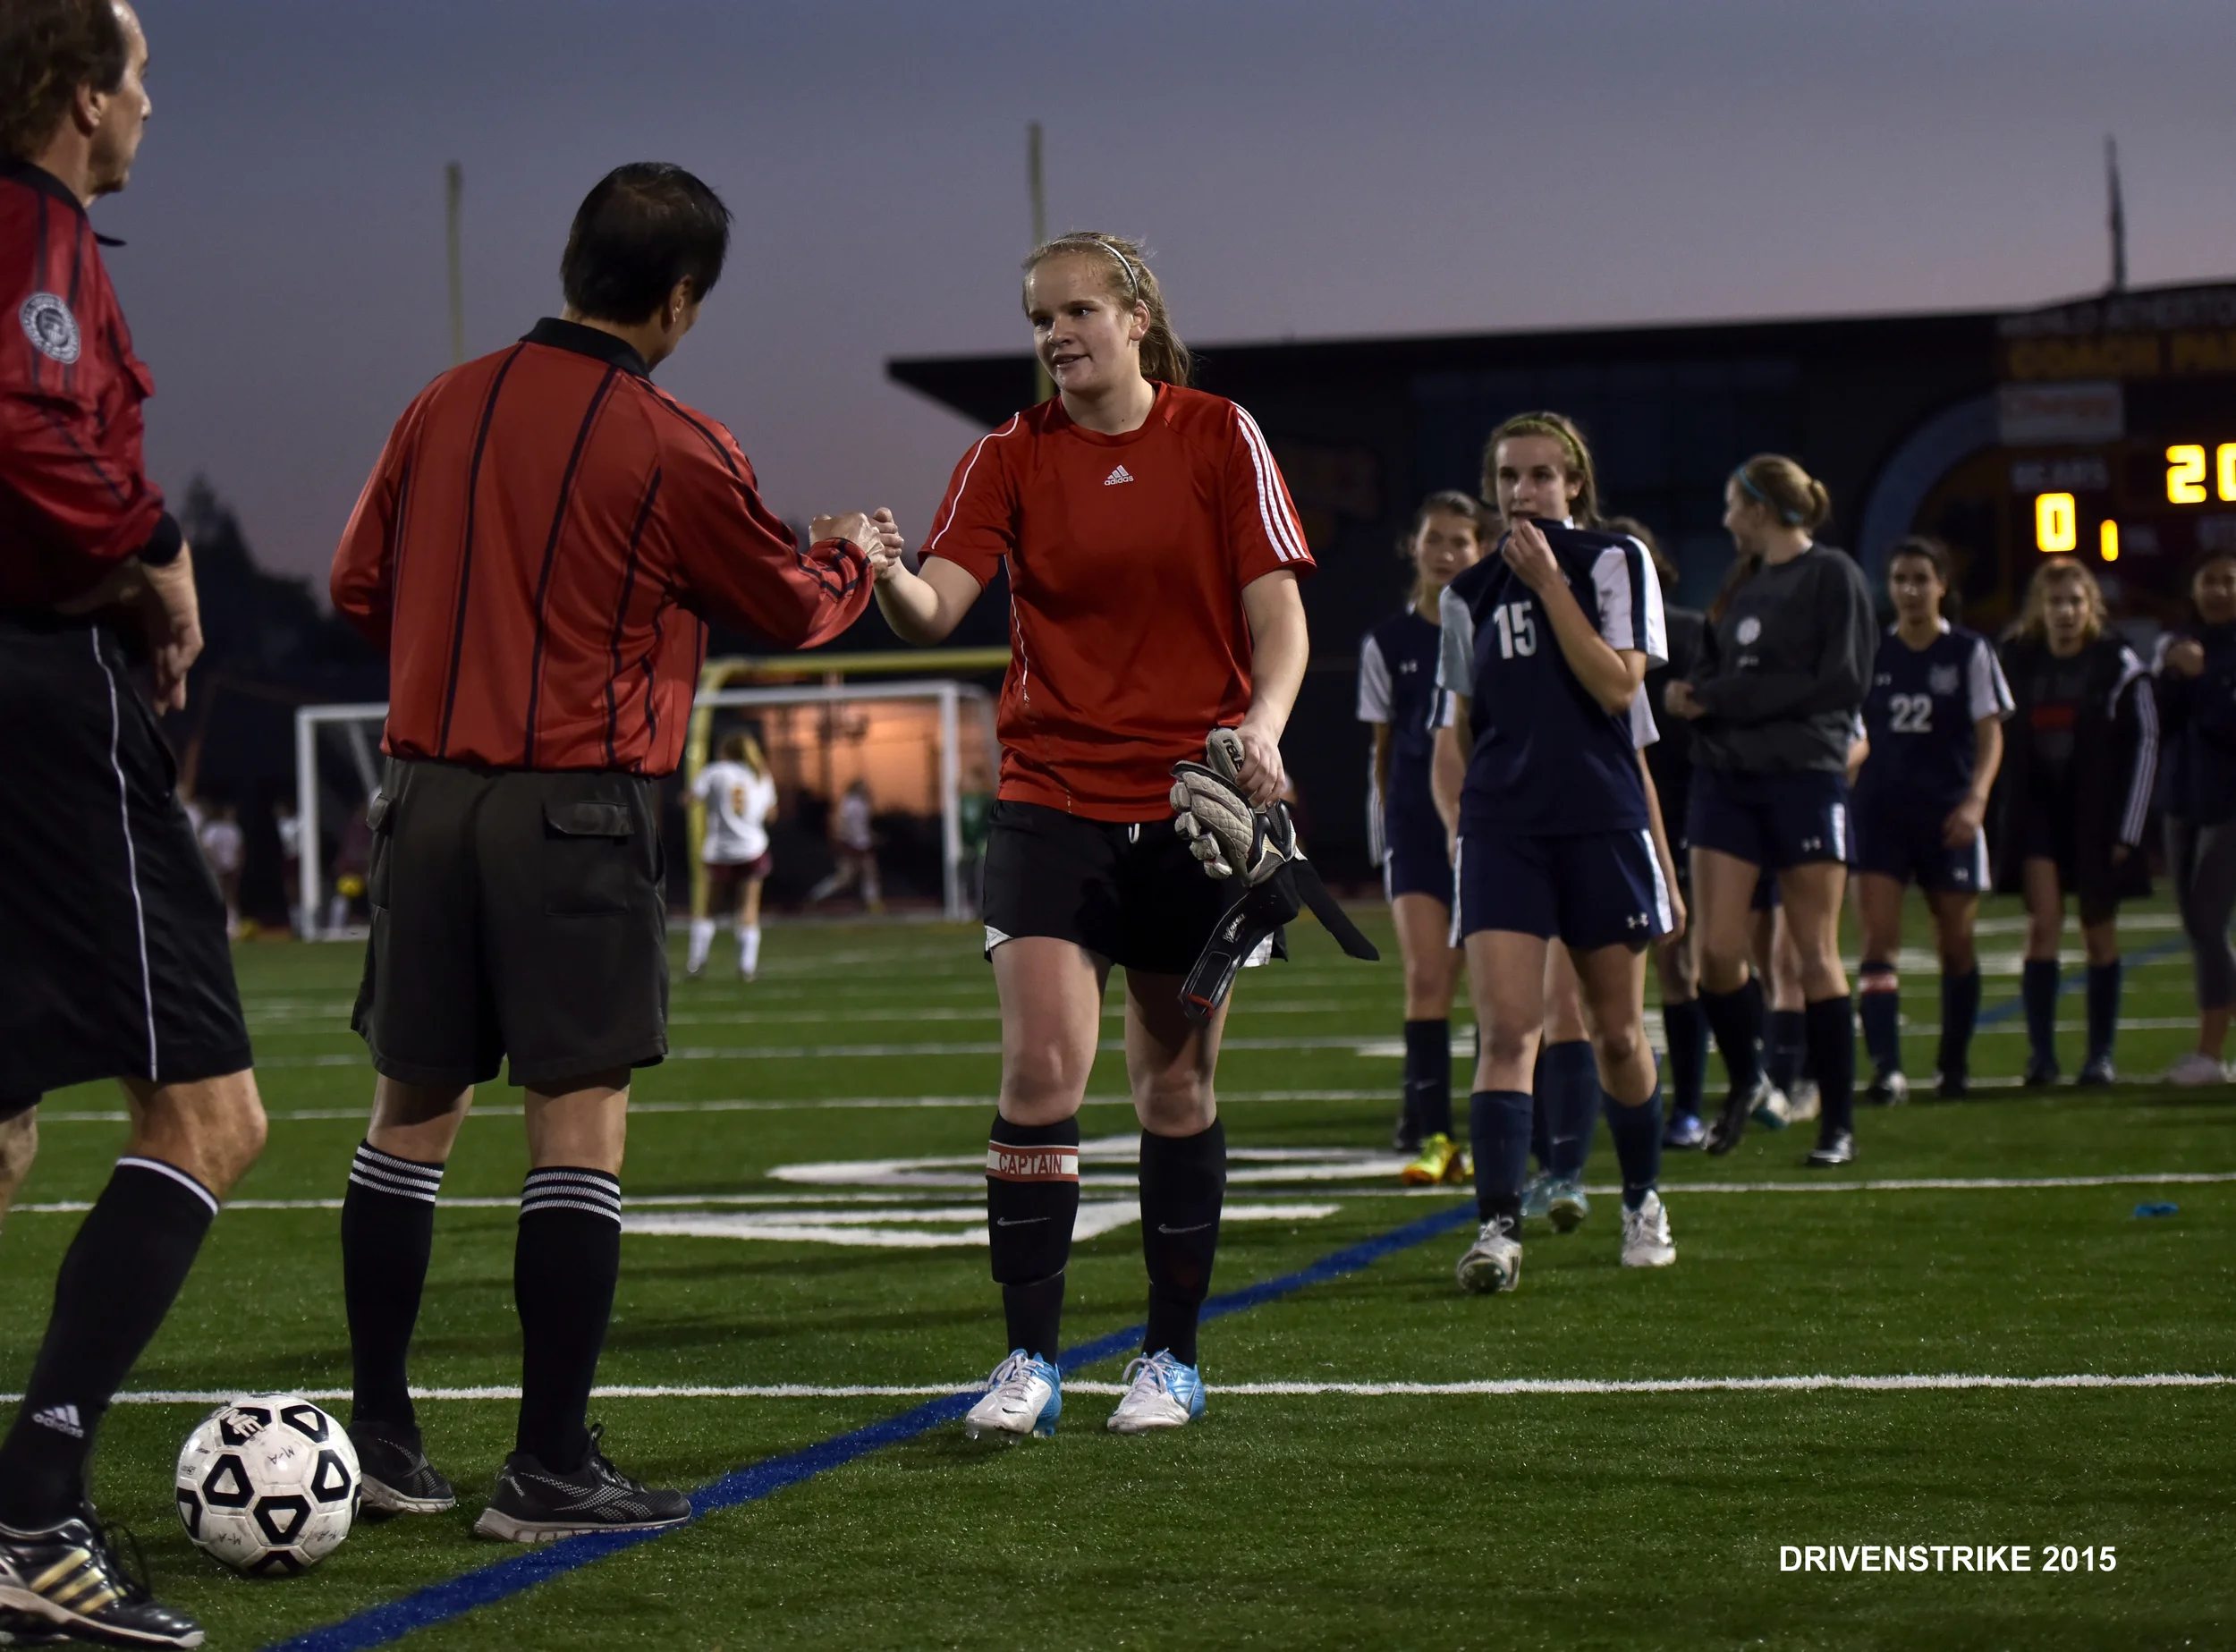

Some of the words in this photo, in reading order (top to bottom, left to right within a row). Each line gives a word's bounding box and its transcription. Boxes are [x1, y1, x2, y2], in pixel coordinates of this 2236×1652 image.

[1104, 475, 1134, 486] adidas
[2035, 492, 2077, 553] 0
[1493, 599, 1537, 660] 15
[1888, 692, 1934, 733] 22
[999, 1153, 1062, 1174] CAPTAIN
[31, 1412, 85, 1439] adidas
